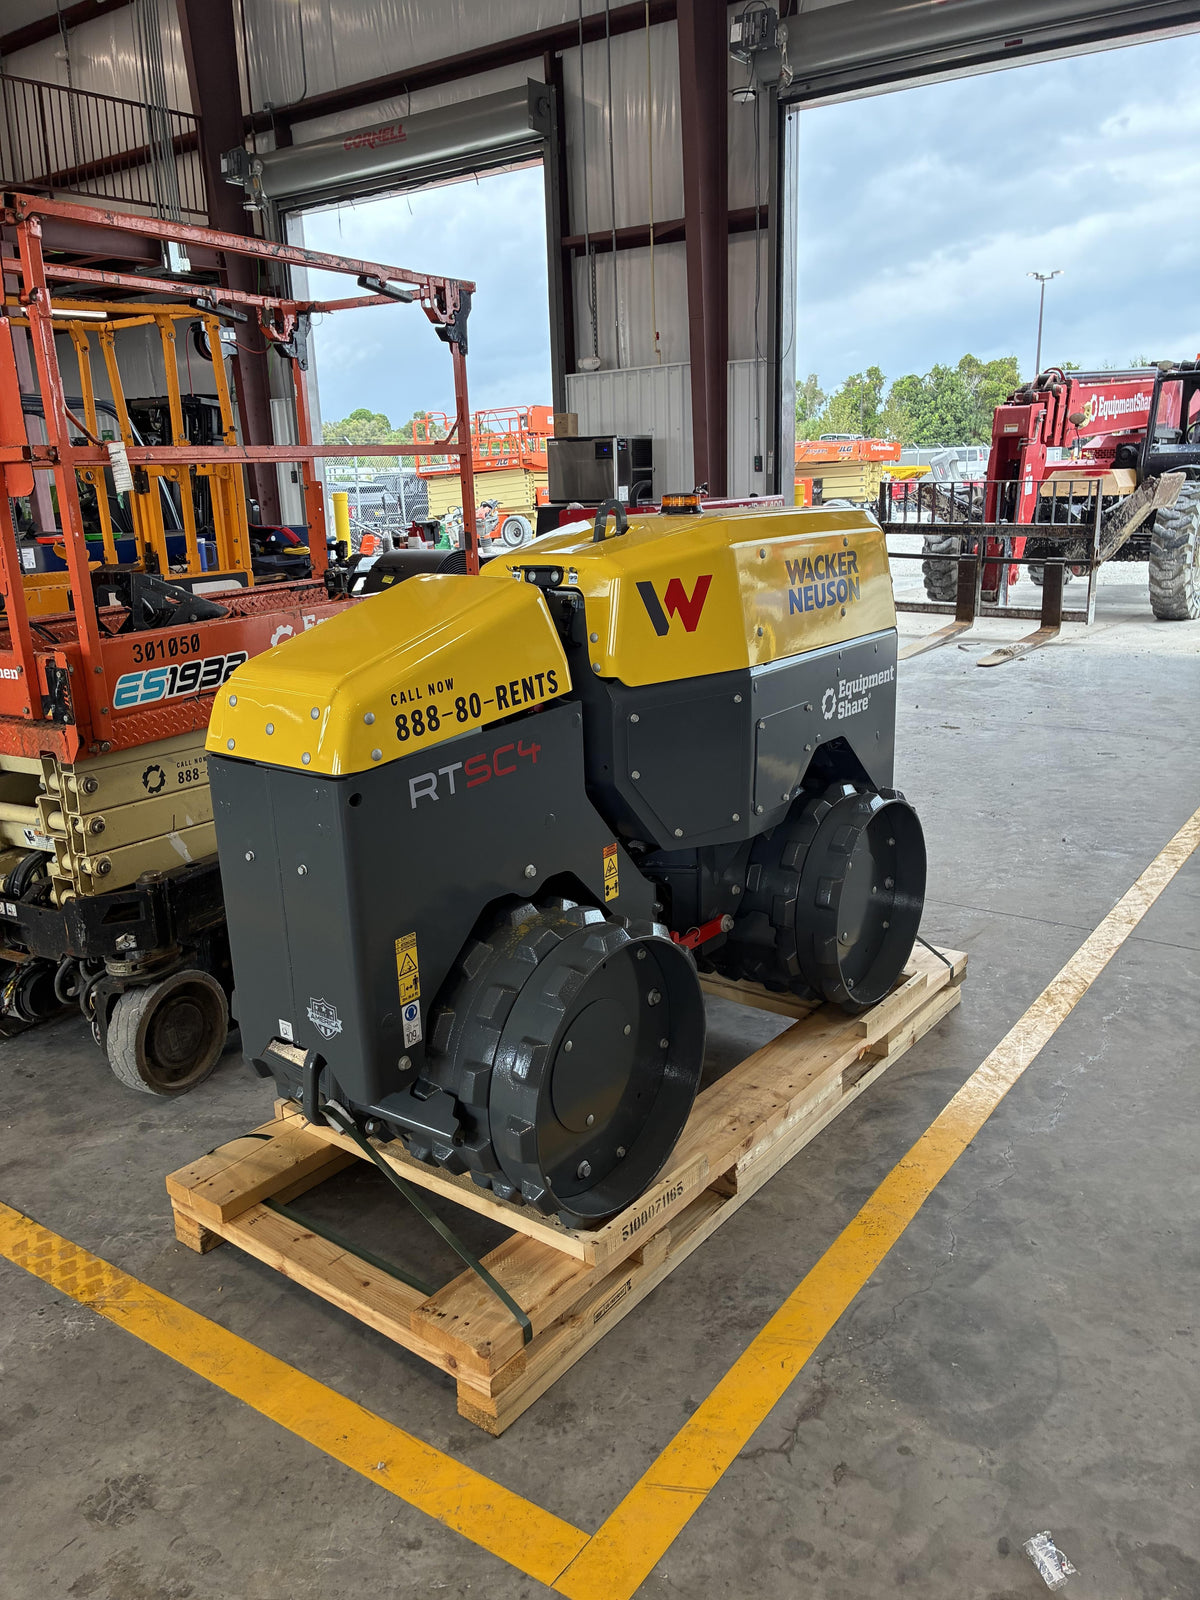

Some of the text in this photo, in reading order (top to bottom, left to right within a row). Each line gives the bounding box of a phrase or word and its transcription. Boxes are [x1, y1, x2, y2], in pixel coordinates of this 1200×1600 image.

[343, 124, 406, 150] CORNELL
[1098, 392, 1152, 420] EquipmentShar
[838, 445, 853, 453] JLG
[785, 550, 859, 586] WACKER
[788, 576, 861, 616] NEUSON
[132, 633, 201, 664] 301050
[114, 651, 248, 709] ES1932
[390, 678, 454, 706] CALL NOW
[838, 665, 895, 699] Equipment
[394, 669, 559, 742] 888-80-RENTS
[837, 696, 869, 720] Share
[176, 760, 192, 768] CALL
[408, 740, 541, 809] RTSC4
